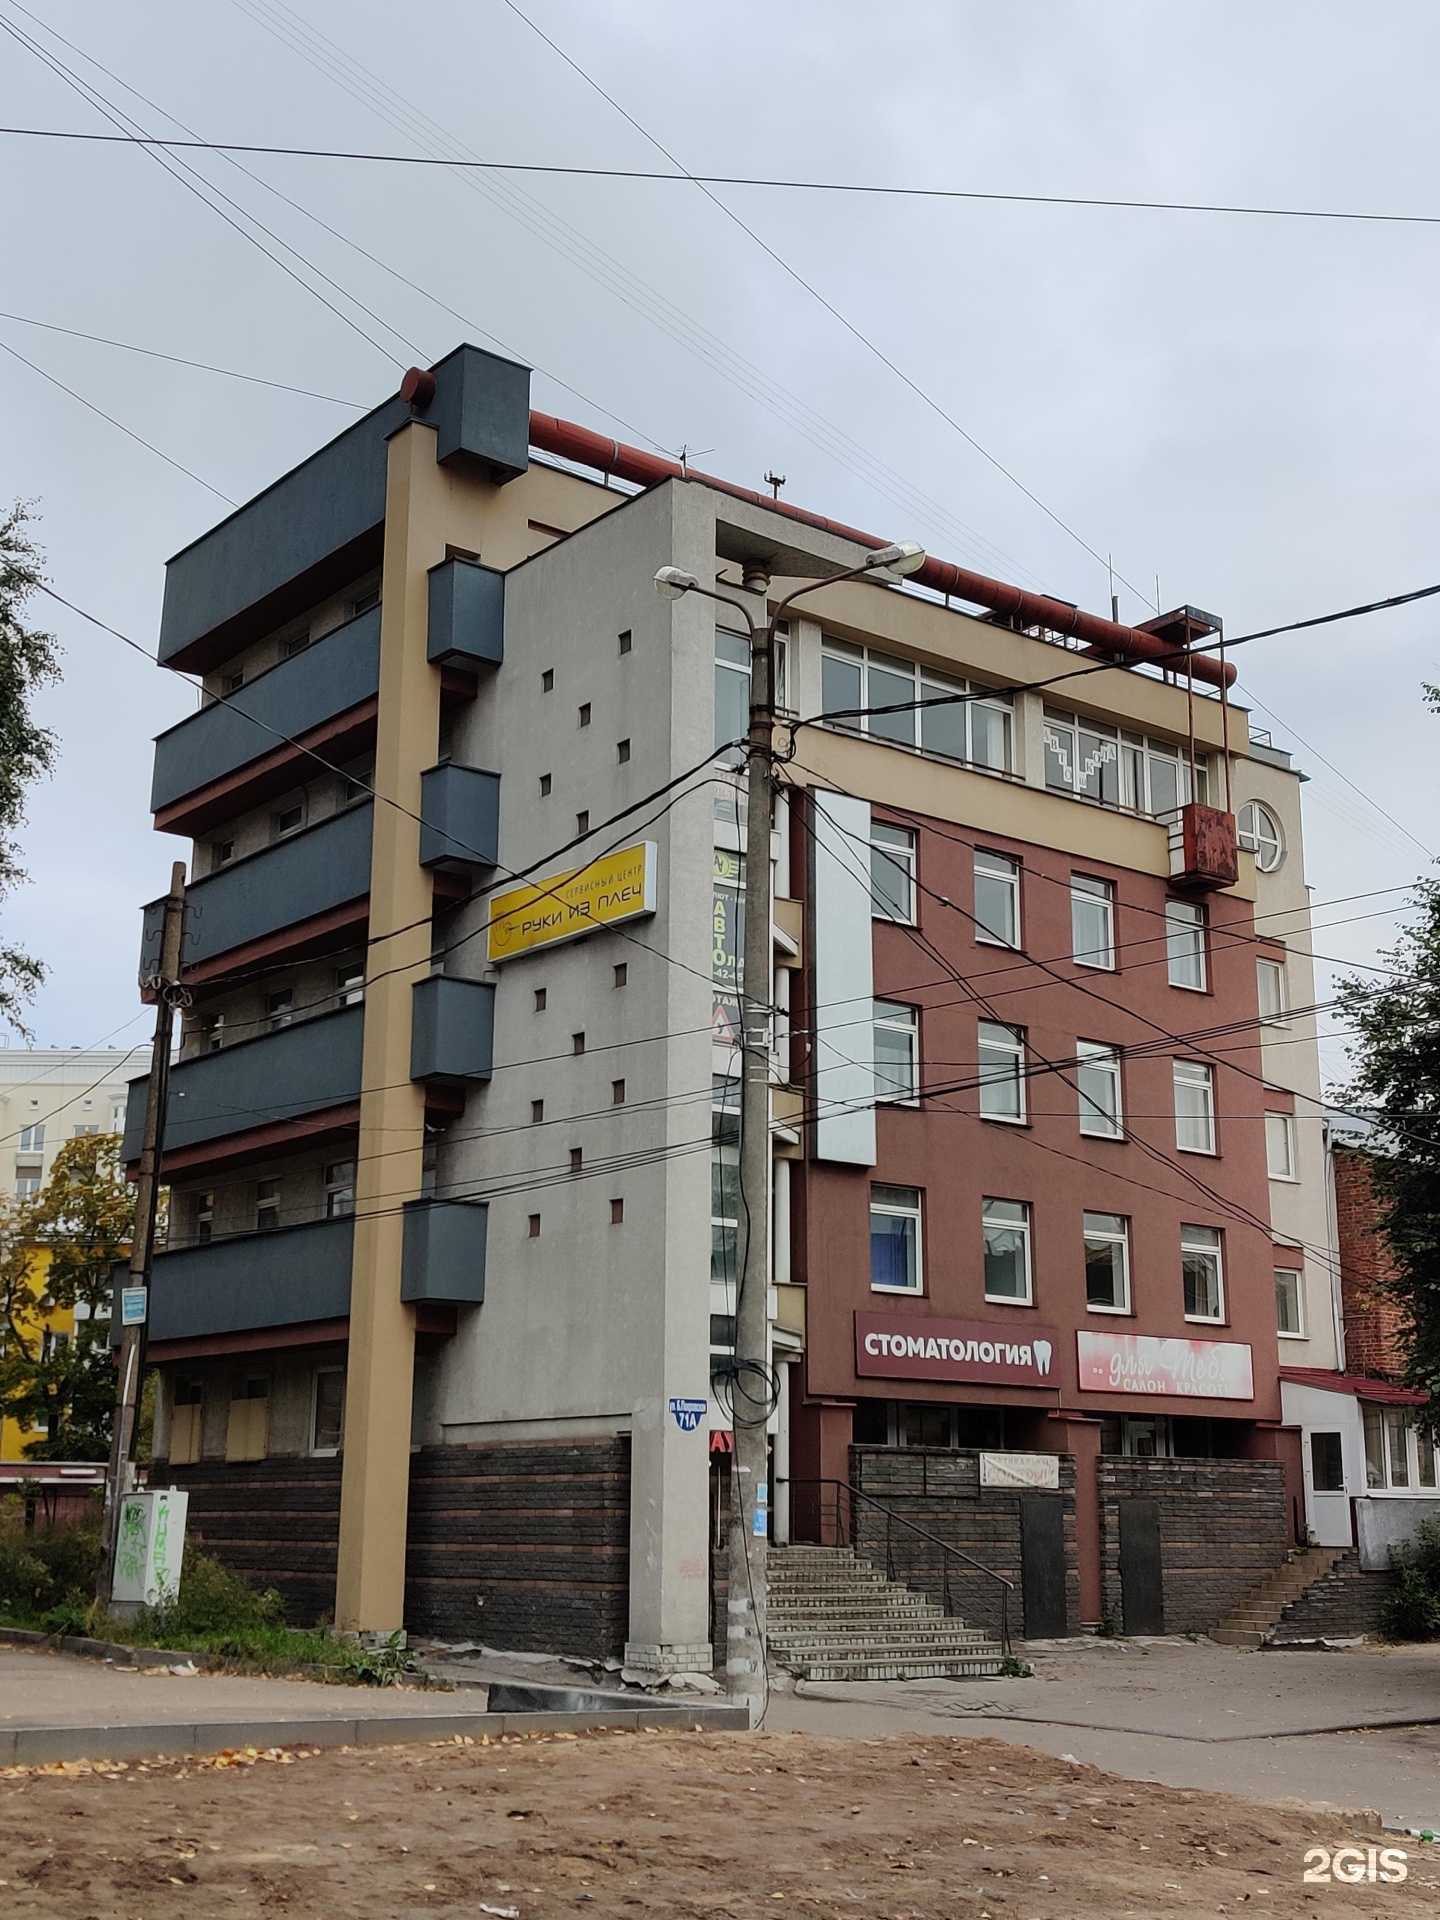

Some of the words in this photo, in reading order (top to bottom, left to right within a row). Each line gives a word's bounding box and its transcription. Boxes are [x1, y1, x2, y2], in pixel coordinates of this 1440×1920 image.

[522, 911, 562, 936] РУКИ
[569, 901, 590, 920] ИЗ
[598, 882, 642, 912] ПЛЕЧ
[864, 1332, 1033, 1367] СТОМАТОЛОГИЯ
[1123, 1378, 1166, 1393] САЛОН
